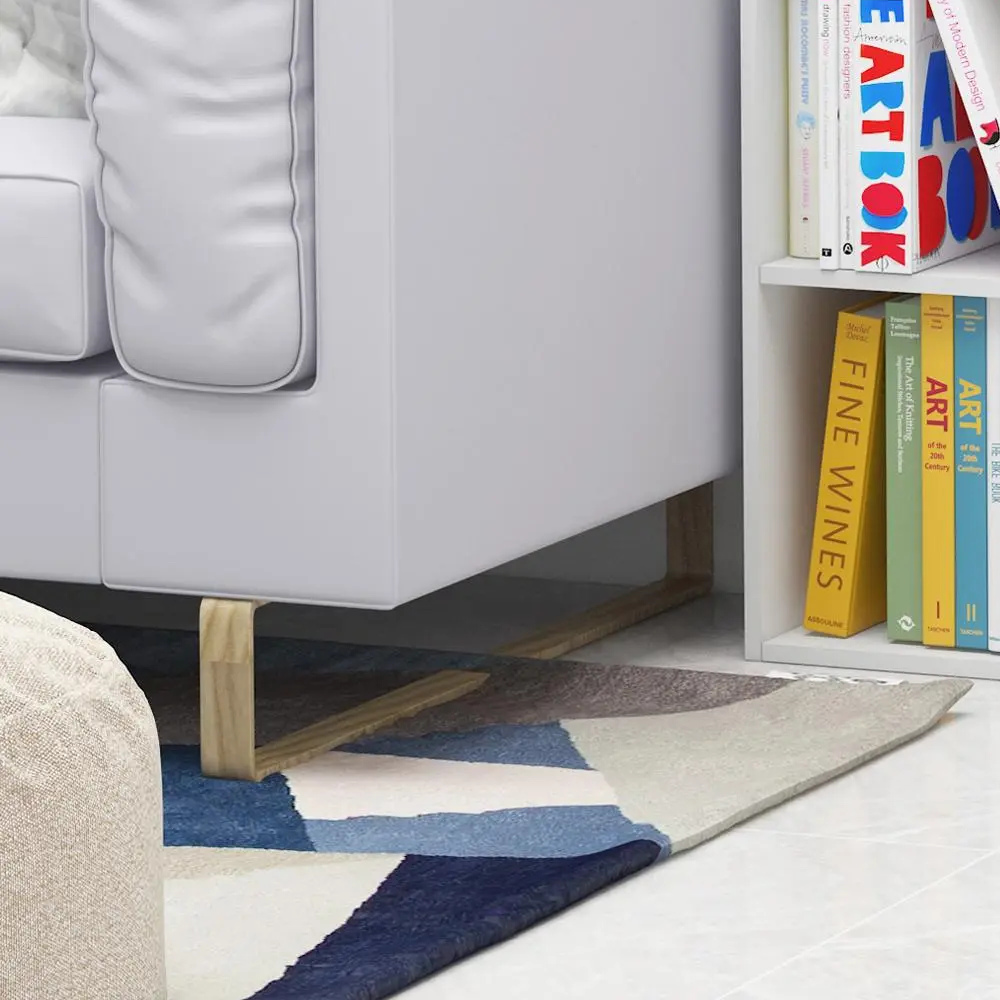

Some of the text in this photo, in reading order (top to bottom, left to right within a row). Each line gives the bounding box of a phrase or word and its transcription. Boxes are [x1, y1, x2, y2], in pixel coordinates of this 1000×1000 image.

[842, 4, 851, 44] fashion
[943, 7, 958, 21] of
[949, 21, 971, 70] Modern
[841, 47, 851, 100] designers
[860, 44, 905, 142] ART
[964, 69, 985, 112] Design
[860, 151, 908, 266] BOOK
[903, 356, 914, 442] The Art of Knitting
[926, 376, 948, 432] ART
[958, 378, 982, 436] ART
[925, 462, 950, 473] Century
[927, 441, 946, 450] of the
[929, 452, 944, 460] 20th
[816, 358, 867, 591] FINE WINES
[807, 615, 843, 629] ASSOULINE
